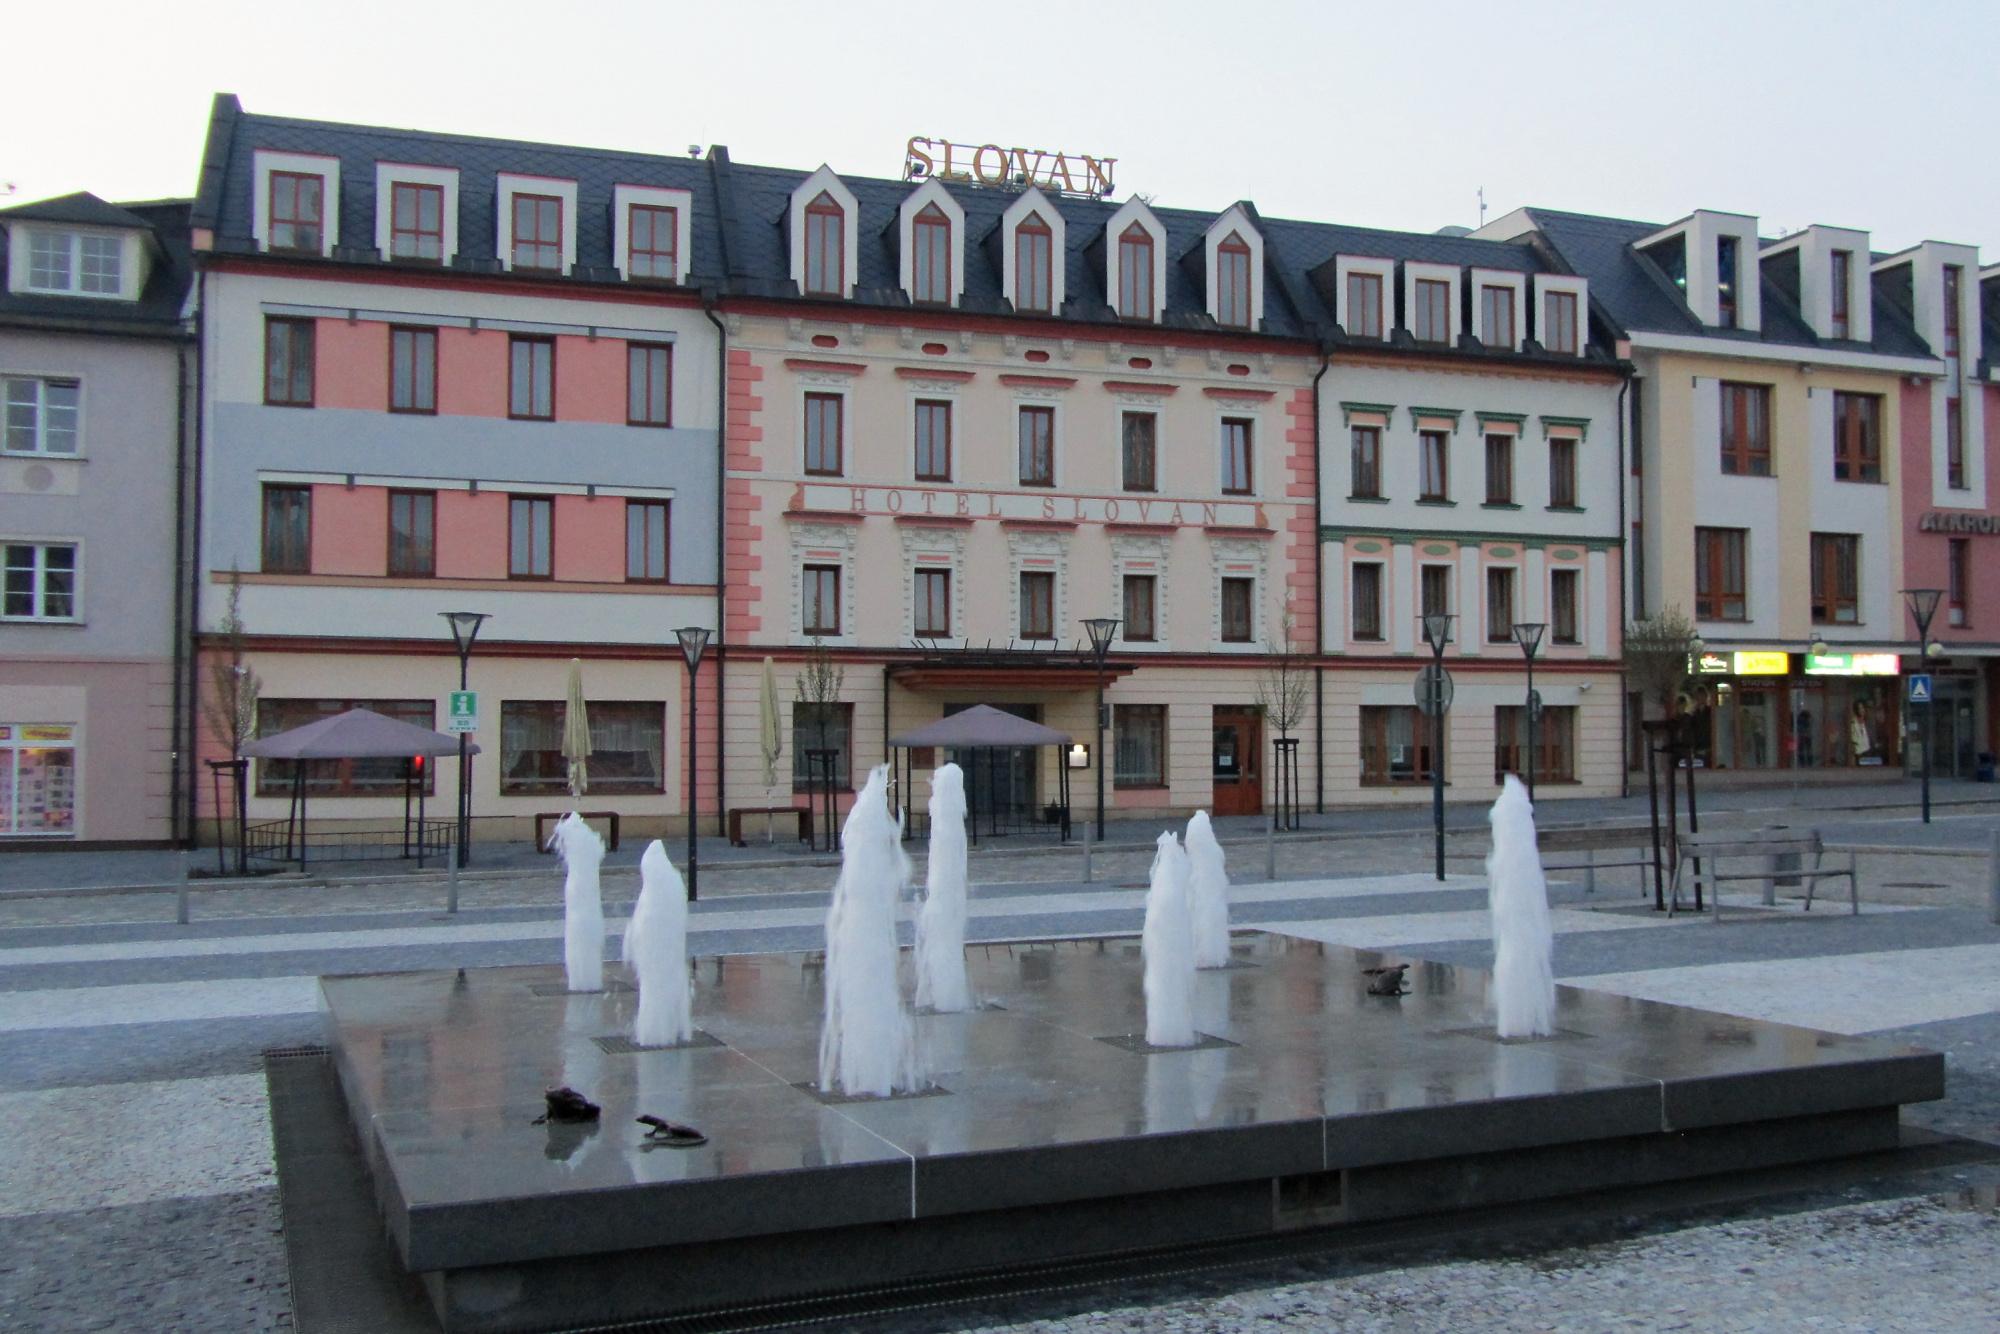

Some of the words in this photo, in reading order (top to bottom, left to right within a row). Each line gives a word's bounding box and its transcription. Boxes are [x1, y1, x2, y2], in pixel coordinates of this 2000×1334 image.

[907, 136, 1118, 194] SLOVAN
[850, 488, 1003, 517] HOTEL
[1042, 496, 1219, 525] SLOVAN
